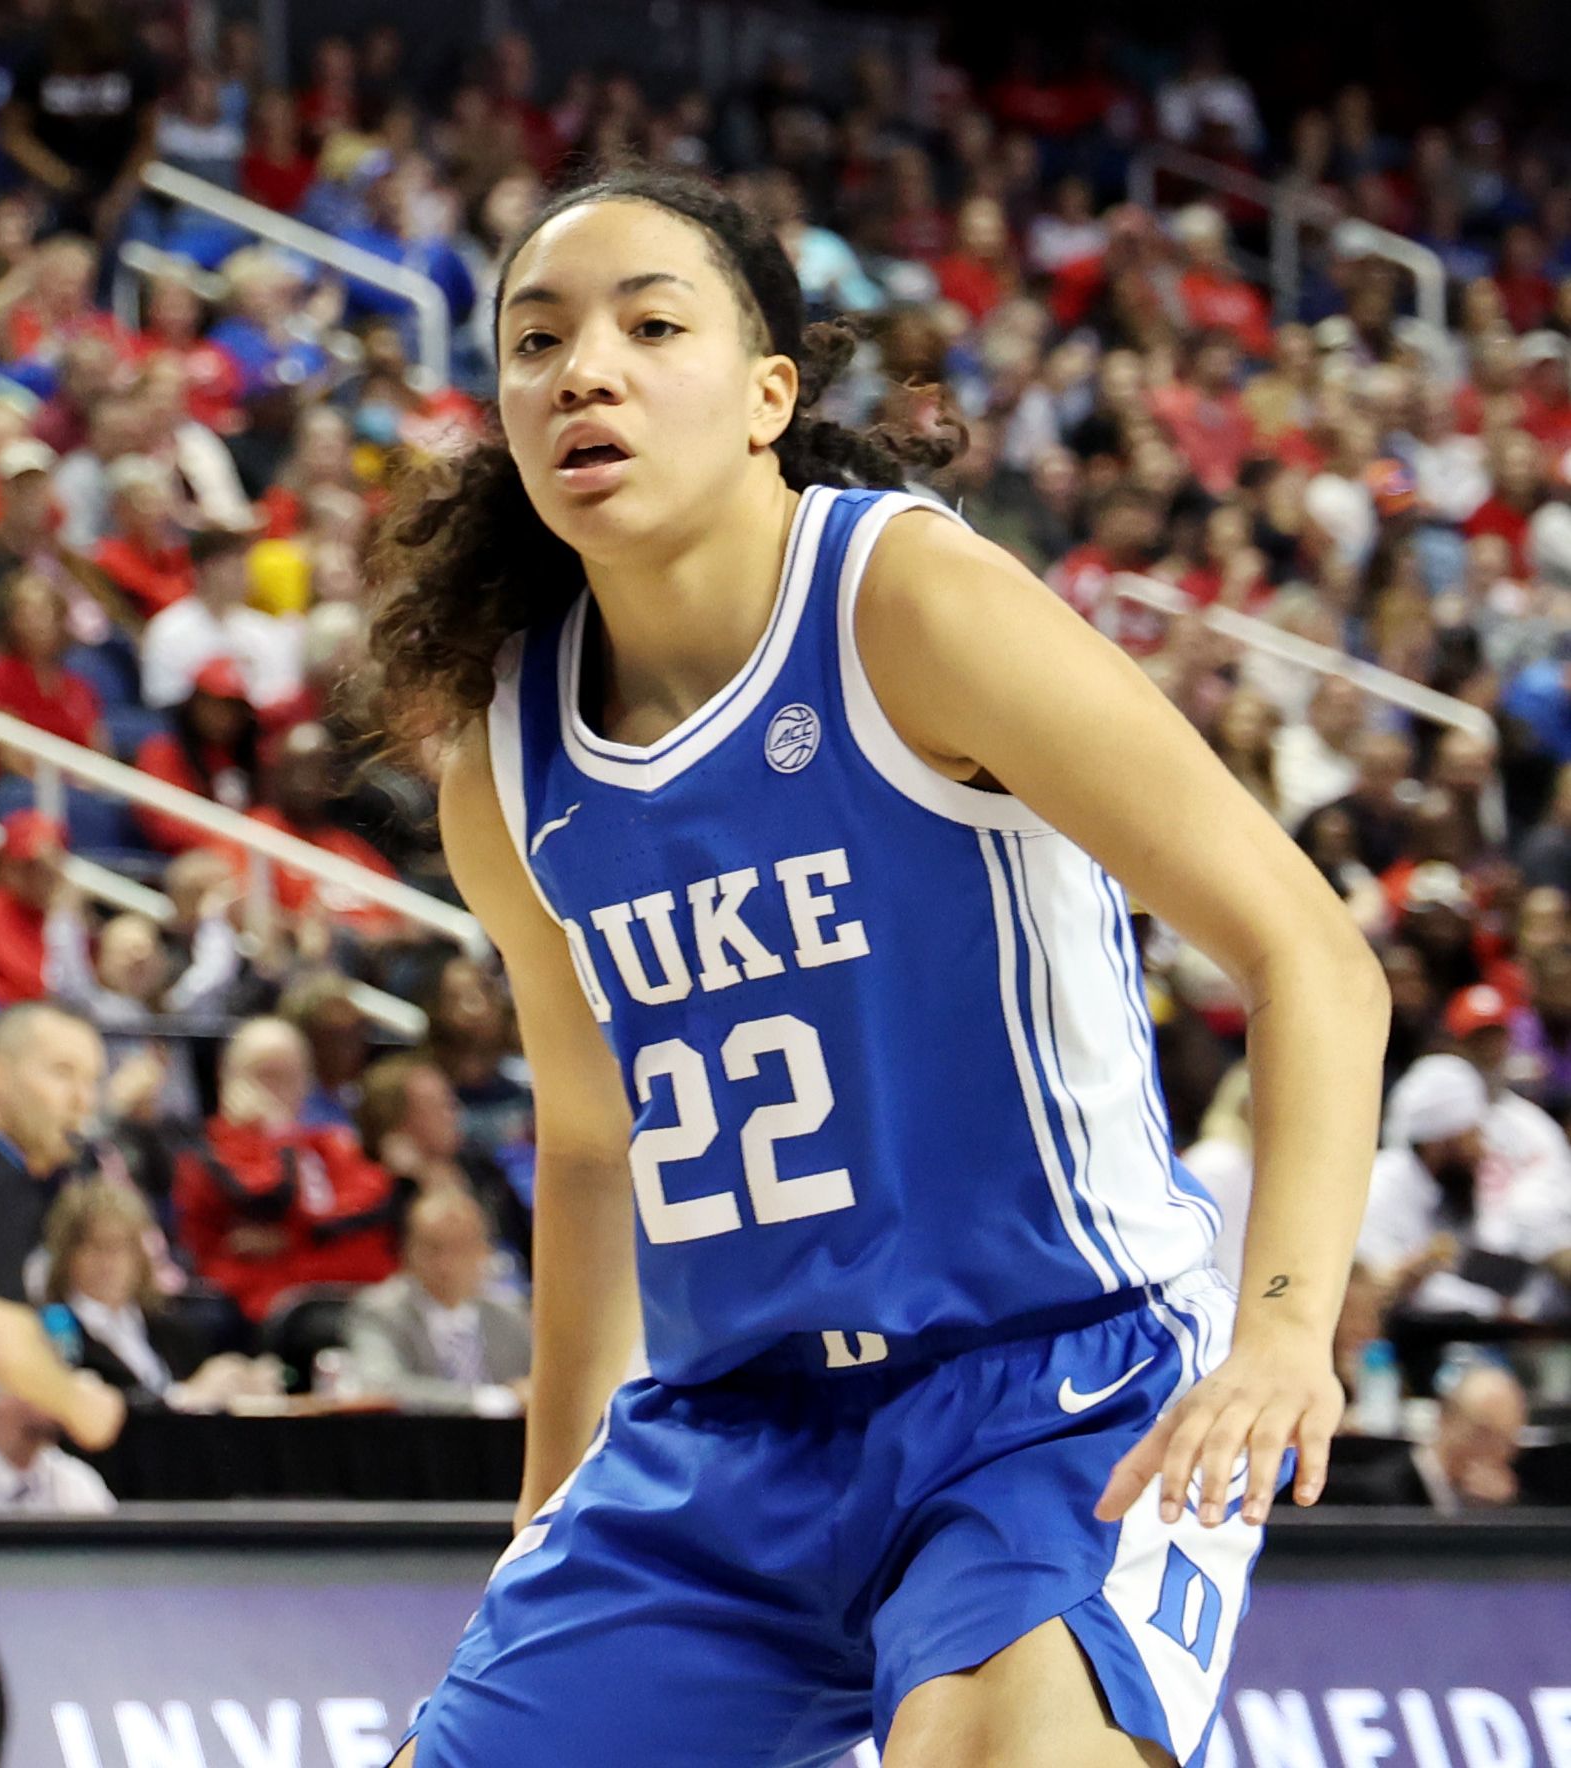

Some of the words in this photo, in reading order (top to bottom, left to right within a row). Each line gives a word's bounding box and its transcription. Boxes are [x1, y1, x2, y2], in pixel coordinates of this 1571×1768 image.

[772, 720, 814, 748] ACC
[629, 1013, 857, 1244] 22
[1261, 1274, 1290, 1299] 2
[1146, 1540, 1223, 1674] D
[50, 1697, 431, 1768] INVE
[1203, 1687, 1571, 1768] NFID
